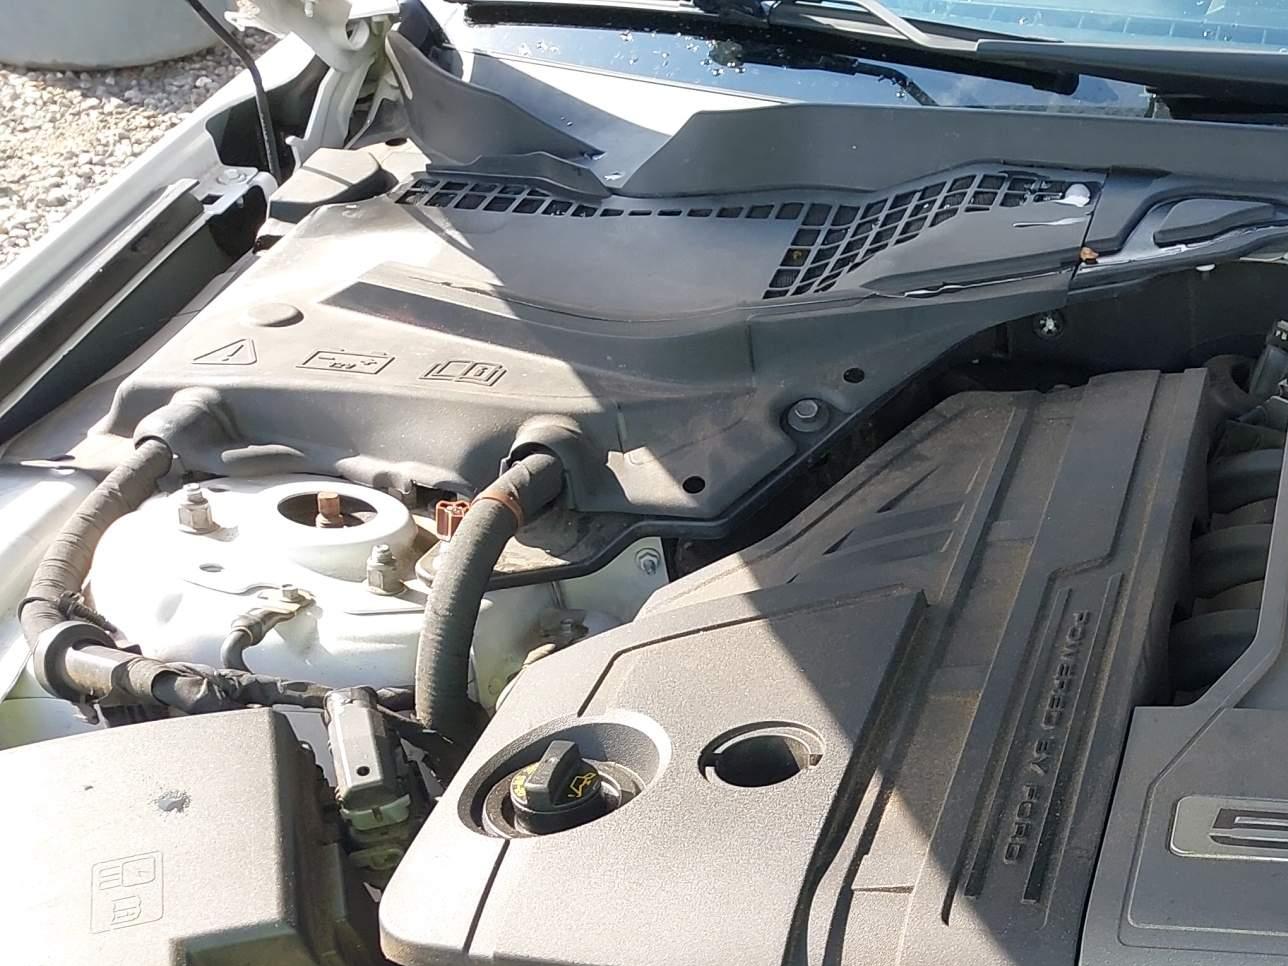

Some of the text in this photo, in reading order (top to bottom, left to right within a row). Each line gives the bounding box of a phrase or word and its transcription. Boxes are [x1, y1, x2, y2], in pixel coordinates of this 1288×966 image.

[1003, 610, 1089, 864] POWERED BY FORD
